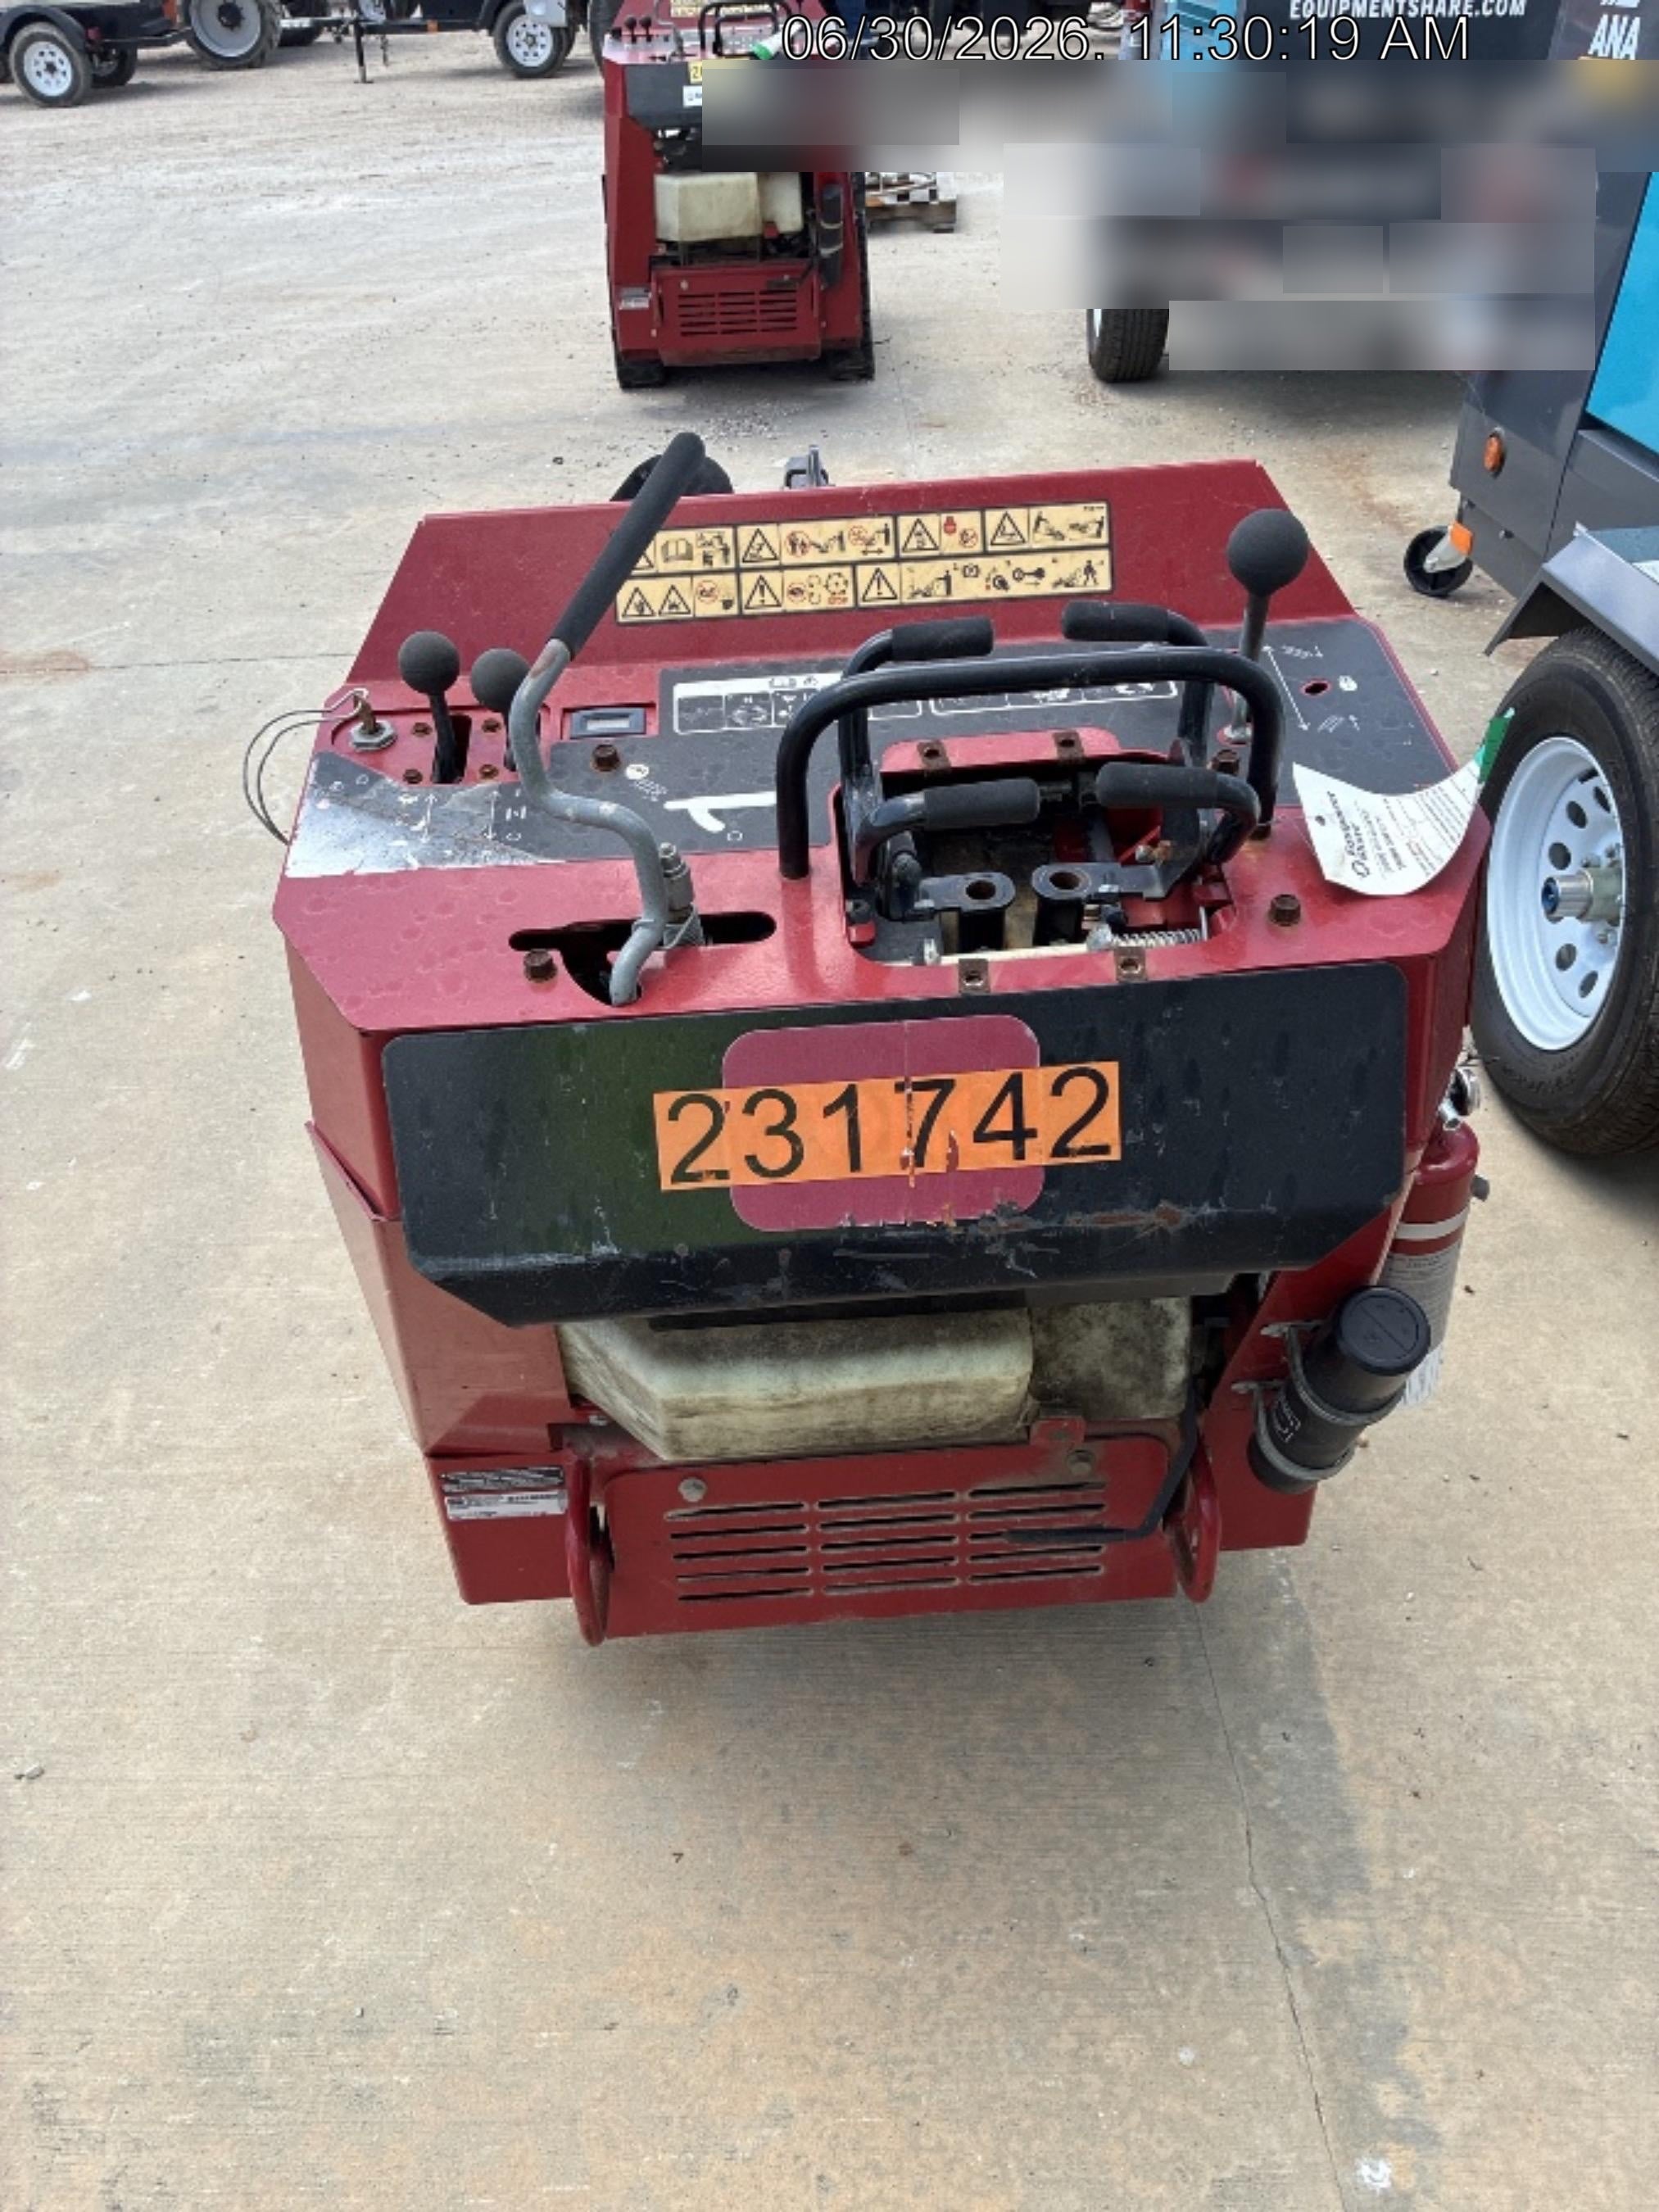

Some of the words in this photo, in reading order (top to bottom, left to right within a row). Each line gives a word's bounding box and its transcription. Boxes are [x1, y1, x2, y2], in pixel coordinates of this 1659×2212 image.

[1290, 0, 1525, 19] EQUIPMENTSHARE.COM
[1588, 14, 1640, 60] ANA
[668, 1067, 1111, 1185] 231742
